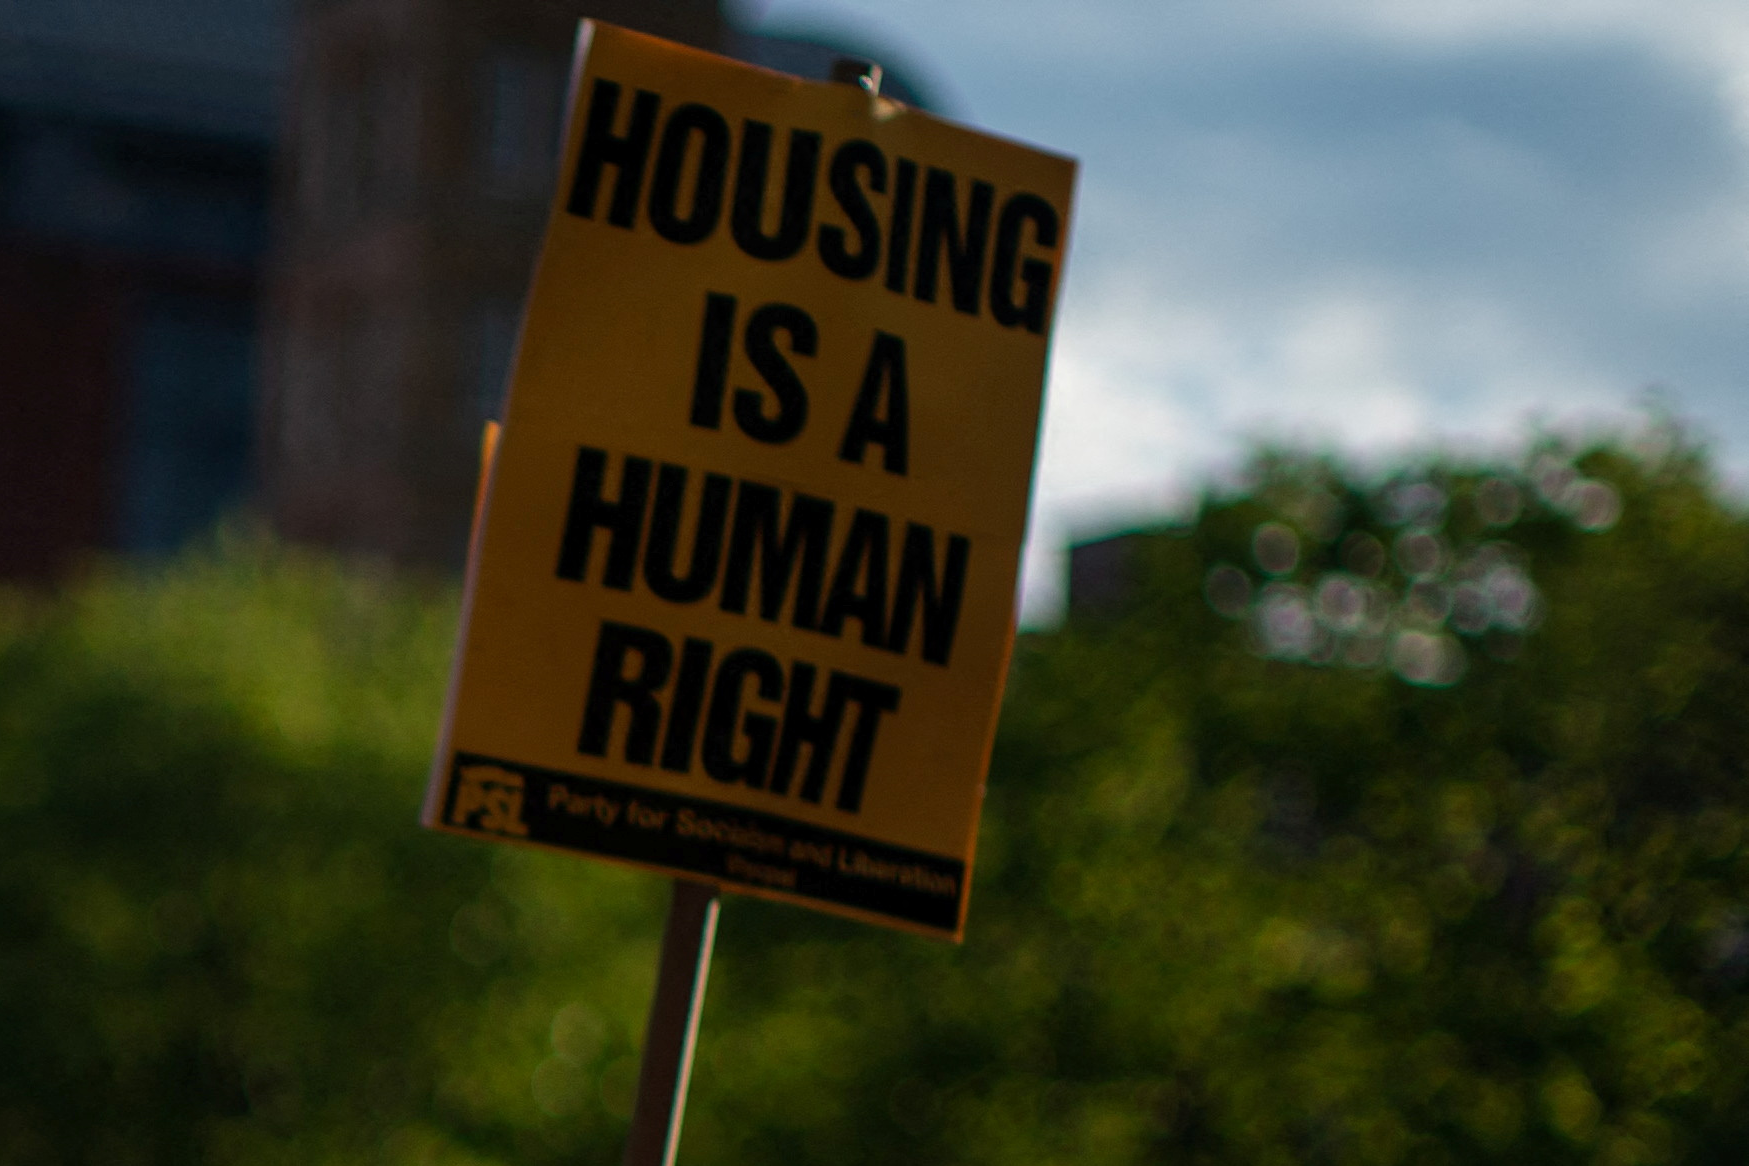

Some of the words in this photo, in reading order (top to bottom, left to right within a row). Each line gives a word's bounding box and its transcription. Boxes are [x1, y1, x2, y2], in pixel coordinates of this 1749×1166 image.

[567, 79, 1057, 335] HOUSING
[690, 294, 817, 442] IS
[840, 332, 908, 475] A
[556, 448, 968, 665] HUMAN
[451, 778, 532, 837] PSL
[547, 783, 619, 826] Party
[627, 801, 667, 834] for
[578, 622, 899, 813] RIGHT
